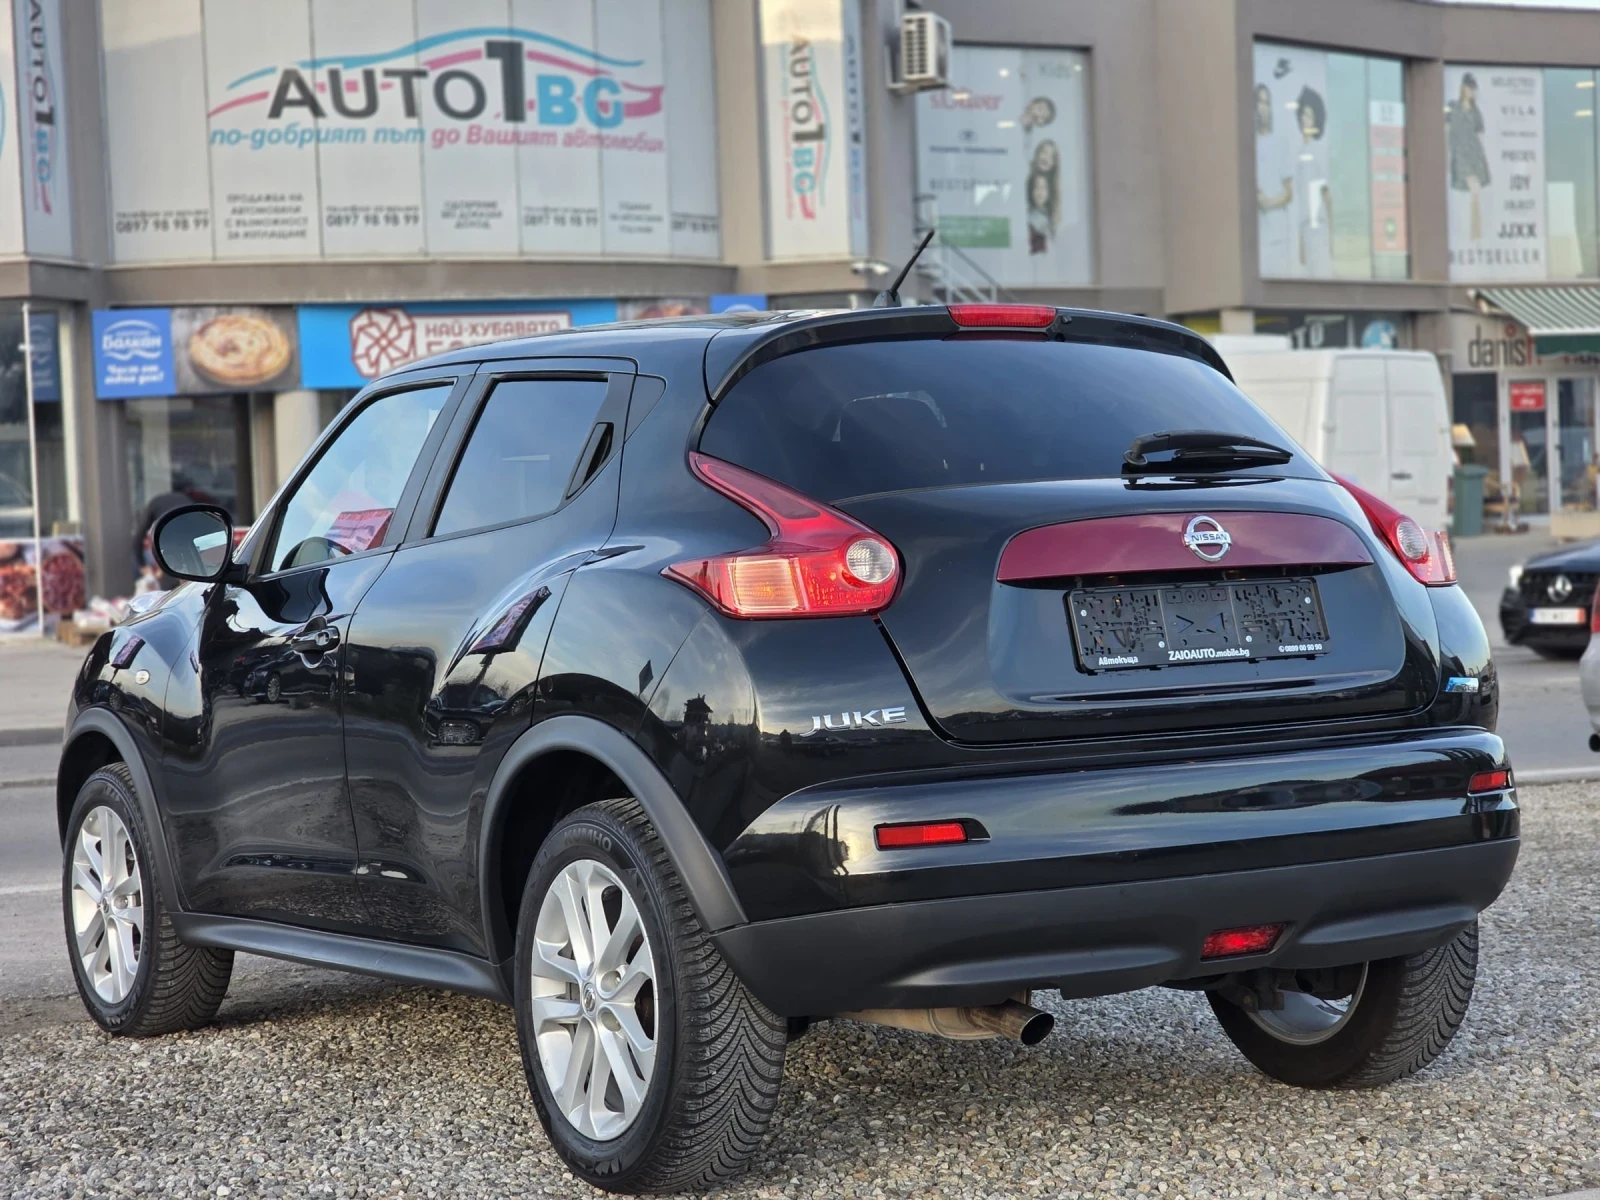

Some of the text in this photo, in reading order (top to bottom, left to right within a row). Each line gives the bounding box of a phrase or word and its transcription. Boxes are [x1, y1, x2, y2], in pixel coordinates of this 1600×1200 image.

[1191, 533, 1227, 542] NISSAN
[799, 706, 907, 738] JUKE
[564, 827, 612, 852] KUMHO
